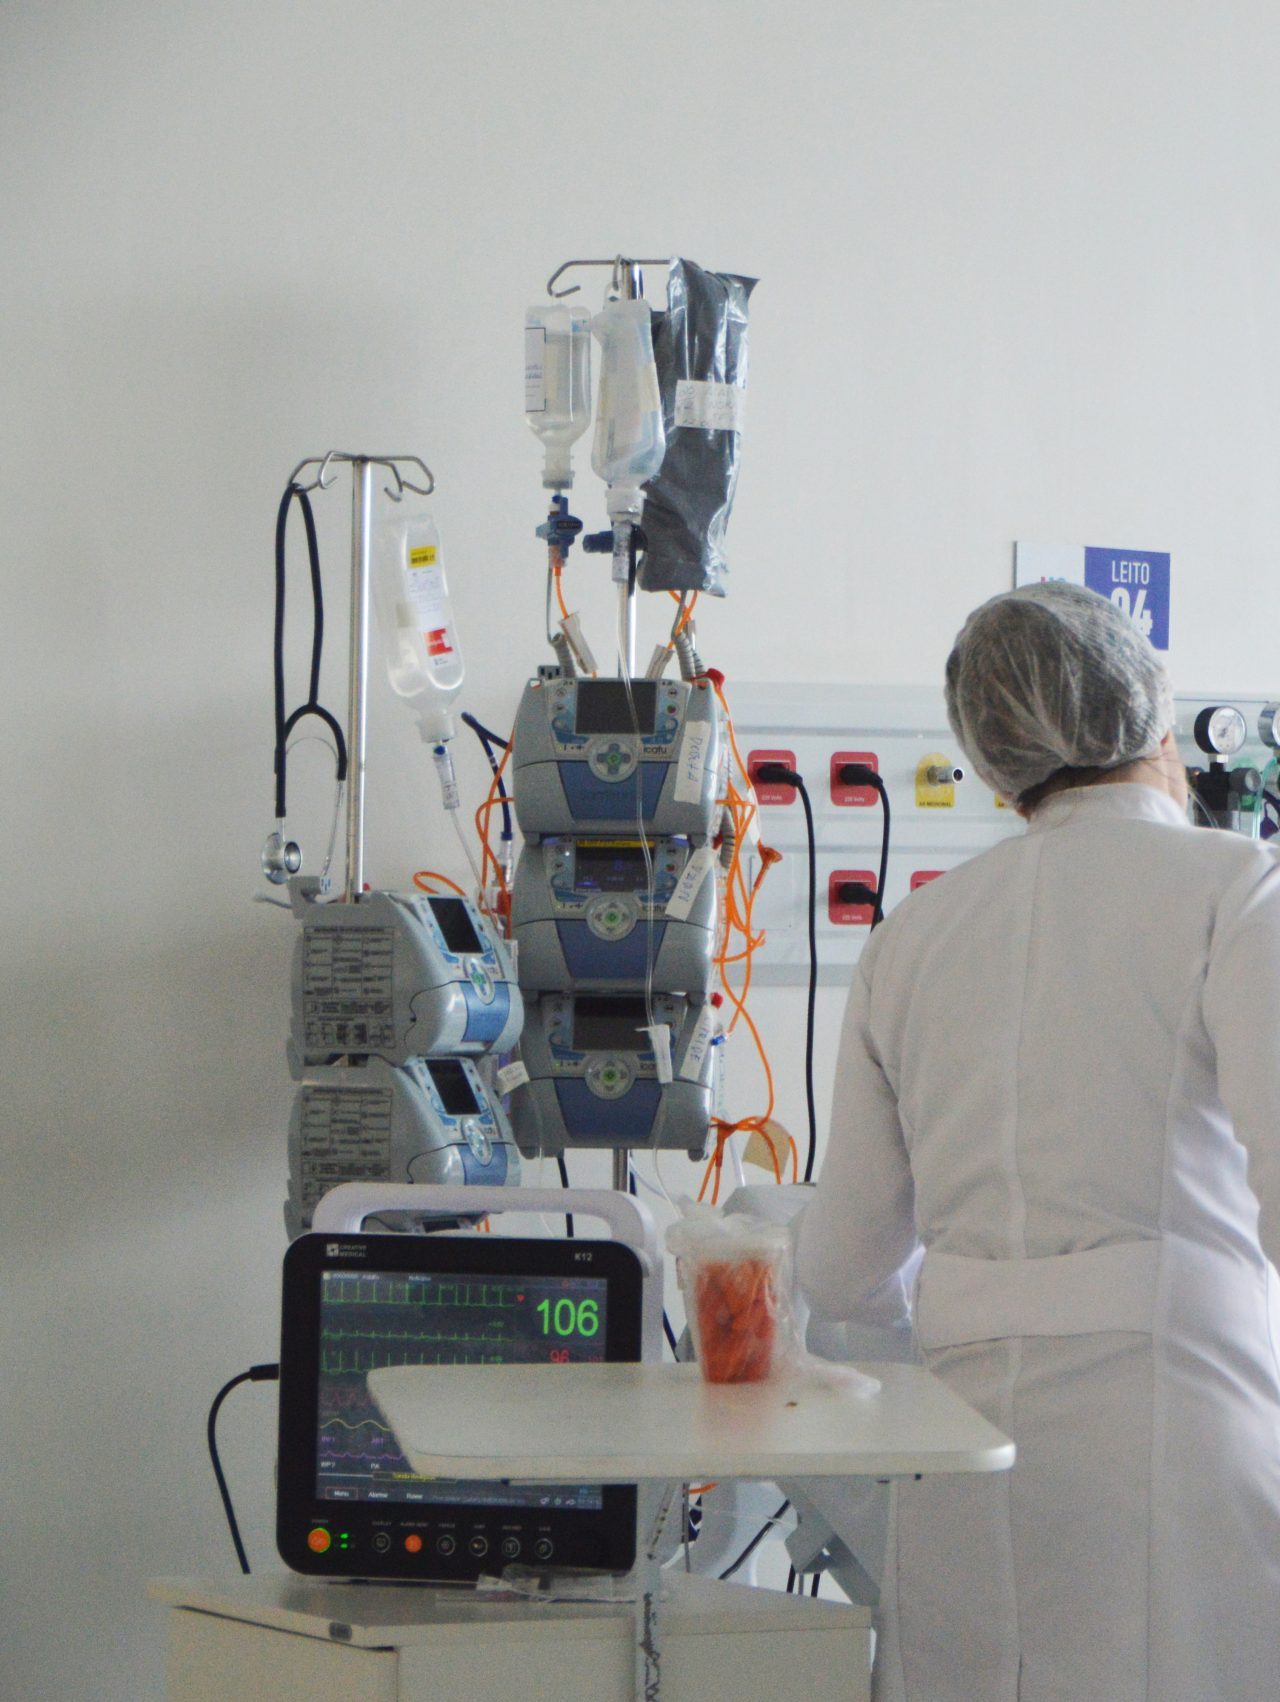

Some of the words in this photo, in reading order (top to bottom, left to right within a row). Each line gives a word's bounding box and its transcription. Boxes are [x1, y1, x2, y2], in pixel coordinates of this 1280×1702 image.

[1112, 560, 1150, 584] LEITO
[575, 1252, 592, 1262] K12
[536, 1298, 599, 1337] 106
